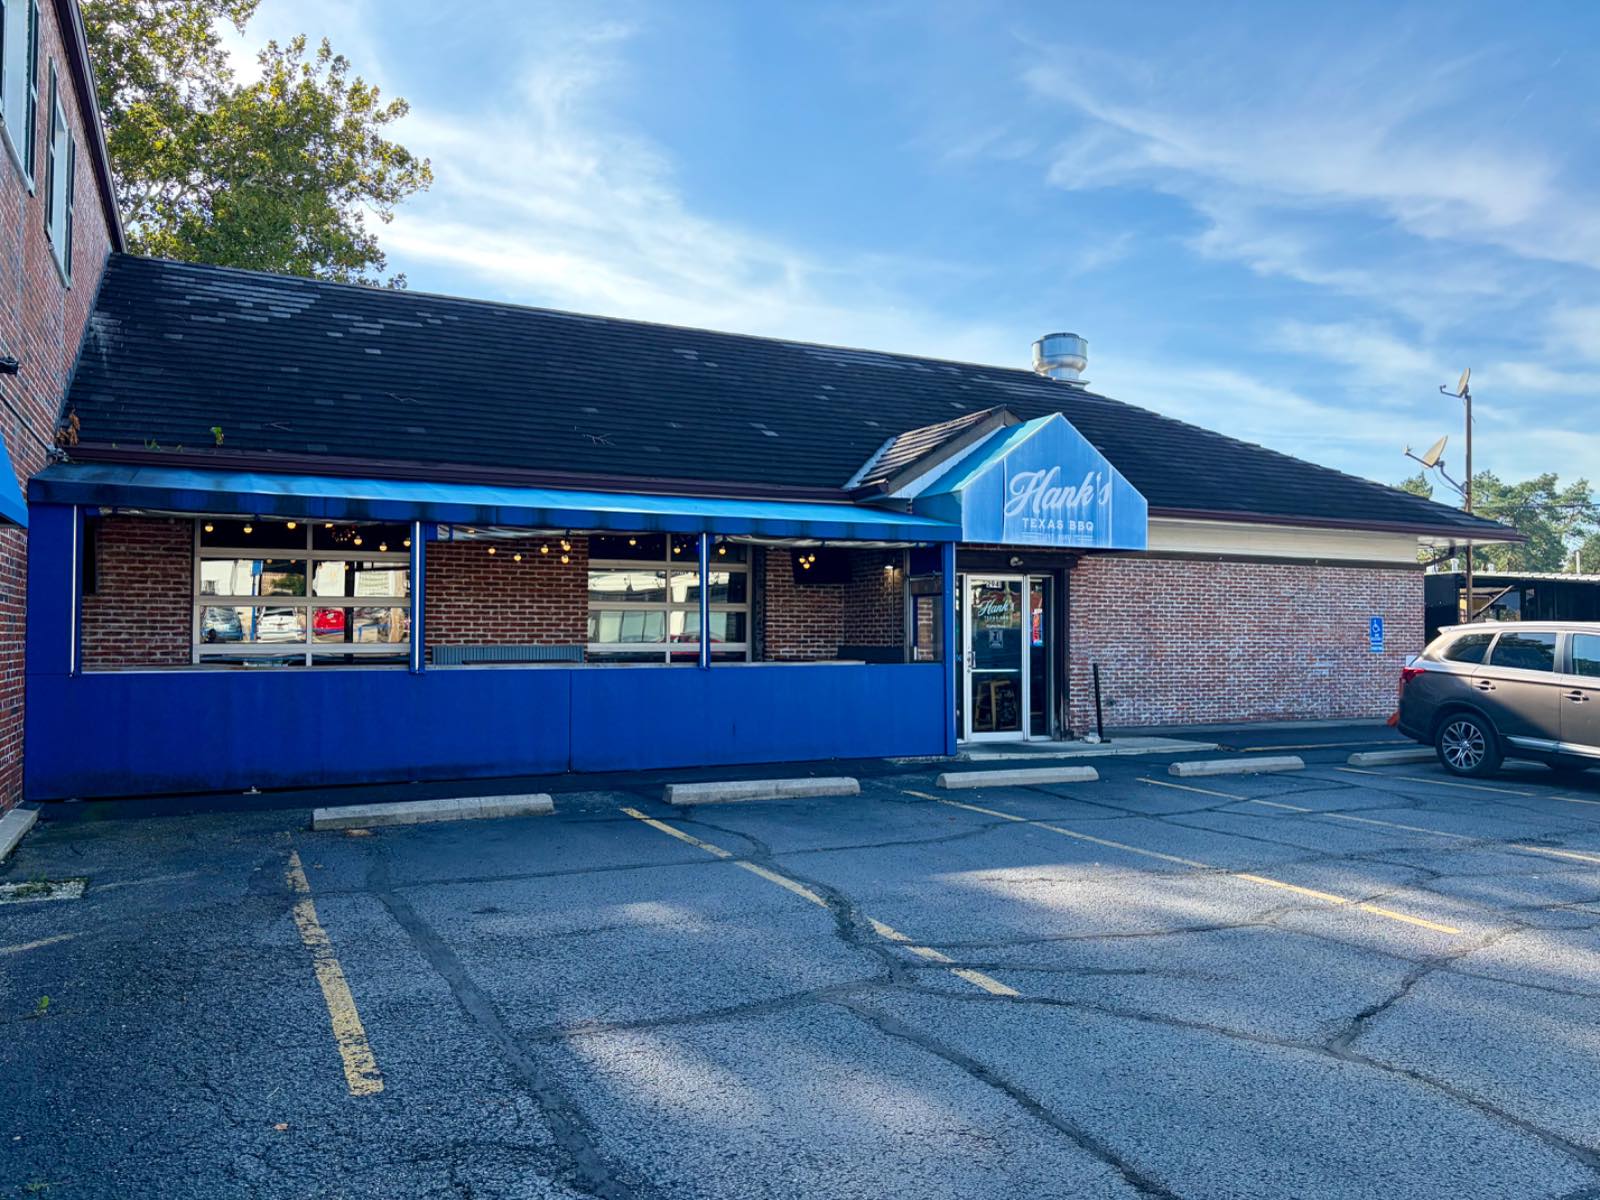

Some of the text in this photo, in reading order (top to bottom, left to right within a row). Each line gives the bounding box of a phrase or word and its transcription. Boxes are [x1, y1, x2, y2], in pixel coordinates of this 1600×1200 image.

[1004, 466, 1112, 516] Hank's
[1022, 518, 1094, 532] TEXAS BBQ
